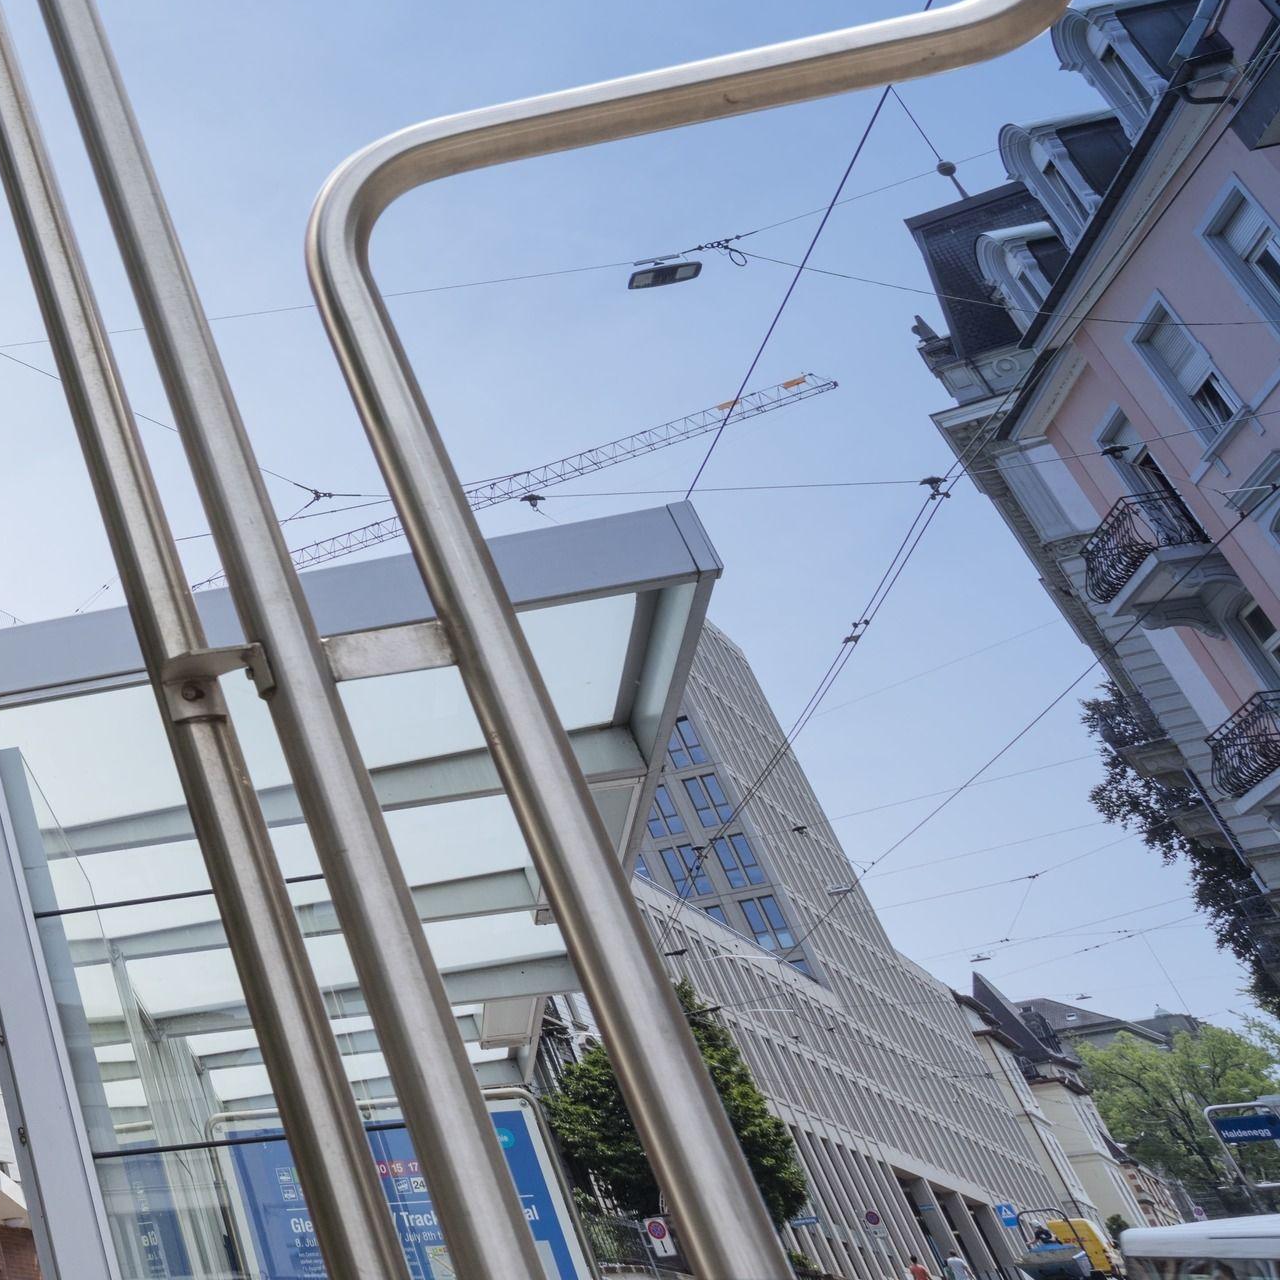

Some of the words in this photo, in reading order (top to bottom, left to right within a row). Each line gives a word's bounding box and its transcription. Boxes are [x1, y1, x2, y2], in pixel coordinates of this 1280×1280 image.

[1221, 1128, 1272, 1138] Haldenegg
[408, 1161, 418, 1172] 17
[413, 1179, 425, 1190] 24
